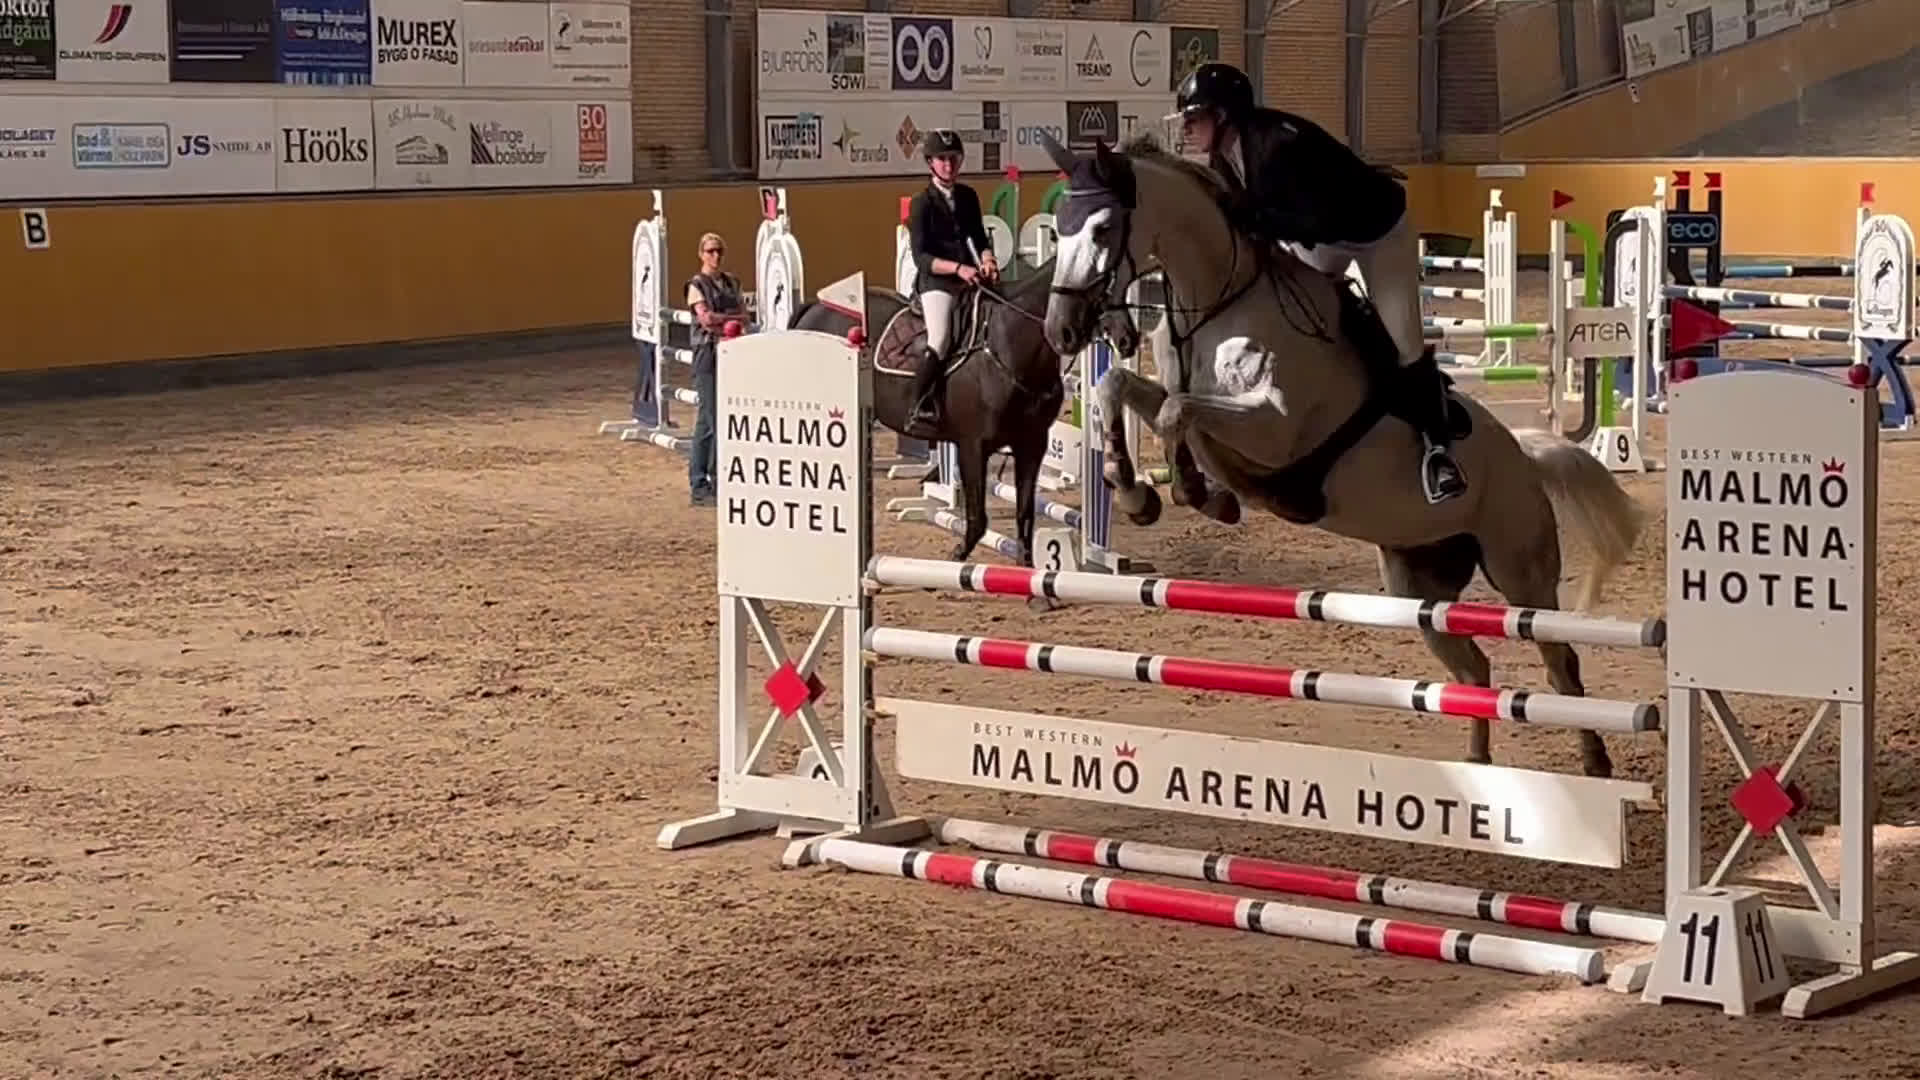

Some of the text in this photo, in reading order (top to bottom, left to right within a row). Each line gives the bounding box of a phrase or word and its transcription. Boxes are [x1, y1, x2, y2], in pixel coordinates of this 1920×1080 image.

[0, 18, 50, 46] dgård
[378, 16, 457, 47] MUREX
[378, 47, 408, 64] BYGG
[411, 47, 419, 60] O
[423, 47, 458, 65] FASAD
[580, 106, 605, 129] BO
[0, 129, 55, 141] OLAGET
[177, 135, 211, 156] JS
[256, 142, 272, 152] AB
[282, 127, 368, 163] Hööks
[476, 120, 524, 149] Vellinge
[850, 143, 889, 162] bravida
[24, 212, 46, 243] B
[1667, 222, 1715, 238] eco
[1568, 322, 1632, 343] ATEA
[727, 397, 822, 411] BEST WESTERN
[1617, 434, 1629, 463] 9
[1681, 449, 1813, 464] BEST WESTERN
[728, 456, 846, 491] ARENA
[729, 497, 847, 534] HOTEL
[1681, 519, 1848, 560] ARENA
[1046, 538, 1061, 571] 3
[1682, 569, 1848, 611] HOTEL
[973, 722, 1103, 746] BEST WESTERN
[1165, 766, 1328, 820] ARENA
[1357, 789, 1524, 844] HOTEL
[1680, 911, 1719, 985] 11
[1745, 909, 1775, 984] 11
